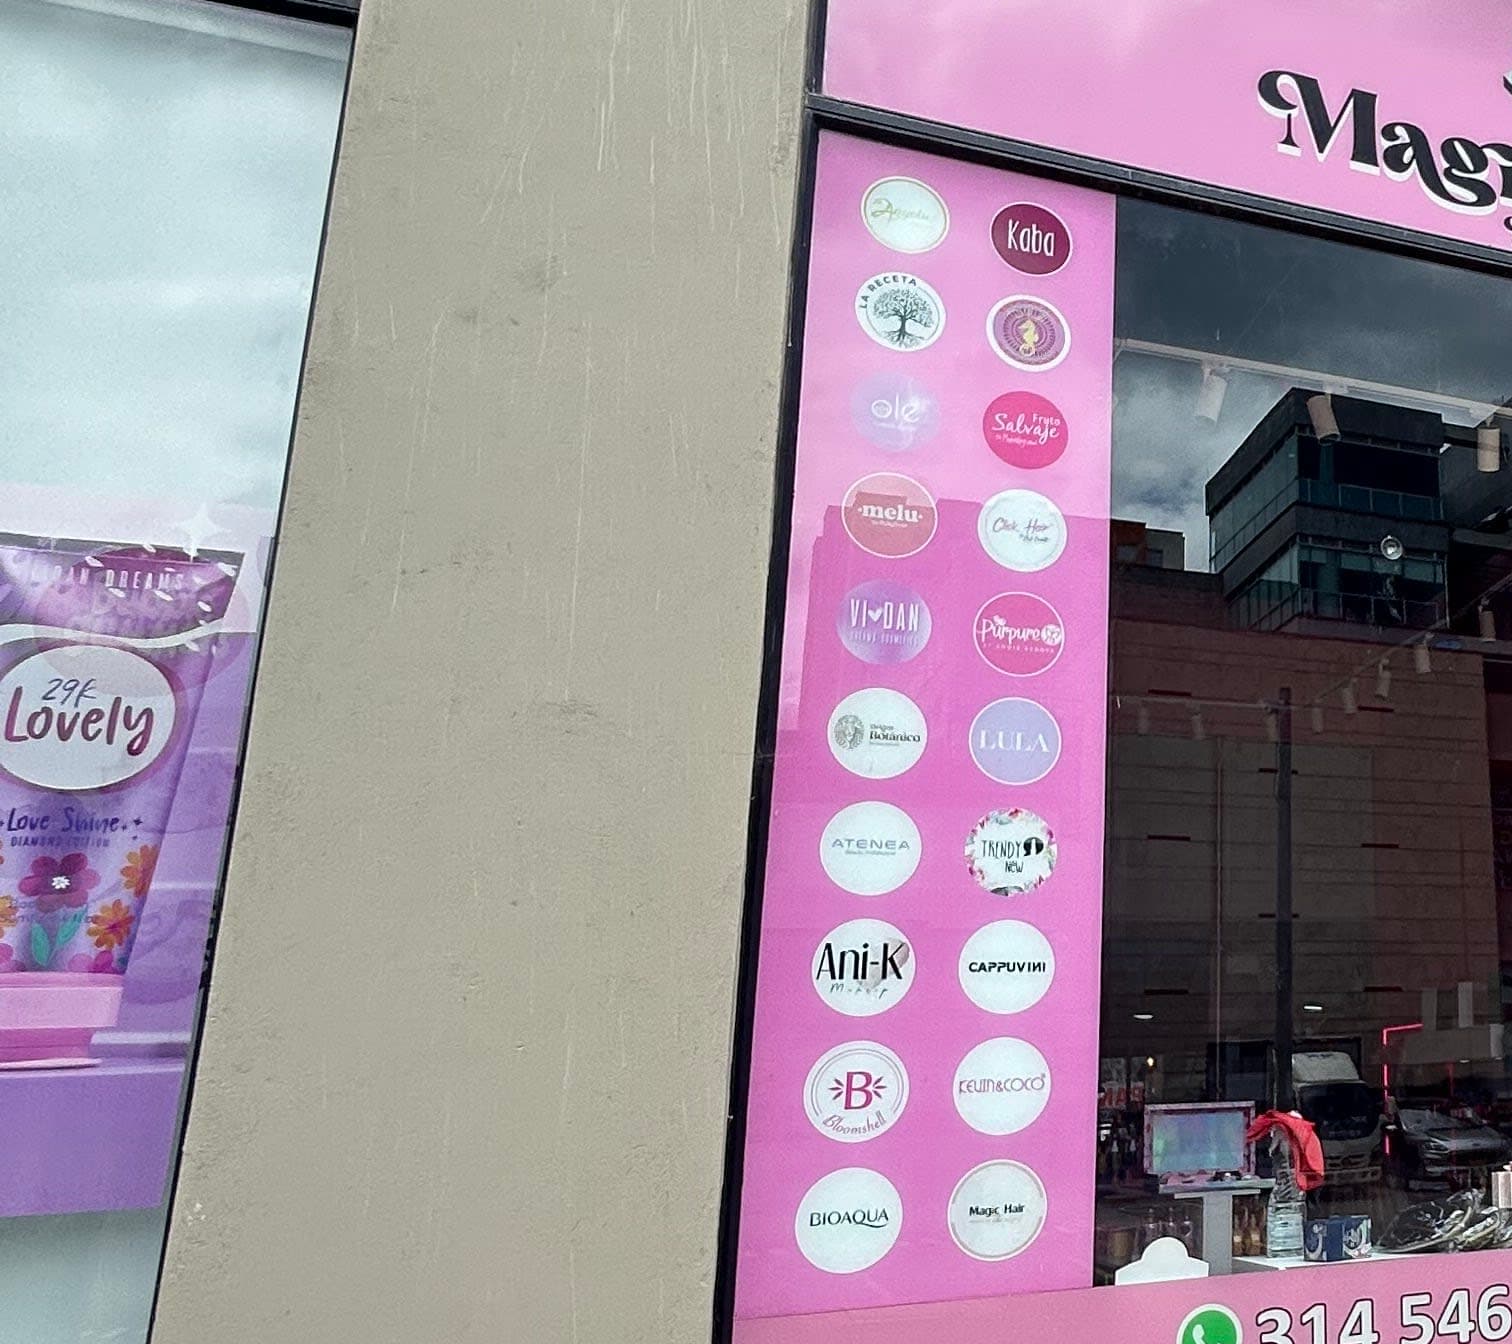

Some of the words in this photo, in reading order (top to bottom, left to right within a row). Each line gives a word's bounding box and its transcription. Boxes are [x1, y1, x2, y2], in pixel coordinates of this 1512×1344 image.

[1007, 219, 1056, 257] Kaba
[867, 274, 918, 294] RECETA
[991, 411, 1061, 446] Salvaje
[105, 568, 185, 590] DREAMS
[4, 685, 156, 757] Lovely
[979, 729, 1050, 754] LULA
[7, 807, 50, 832] Love
[832, 838, 911, 851] ATENEA
[981, 839, 1024, 859] TRENDY
[815, 941, 907, 981] Ani-K
[843, 1070, 873, 1111] B
[822, 1111, 888, 1136] Bloomshell
[809, 1208, 890, 1229] BIOAQUA
[969, 1205, 1000, 1217] Magic
[1003, 1203, 1026, 1214] Hair
